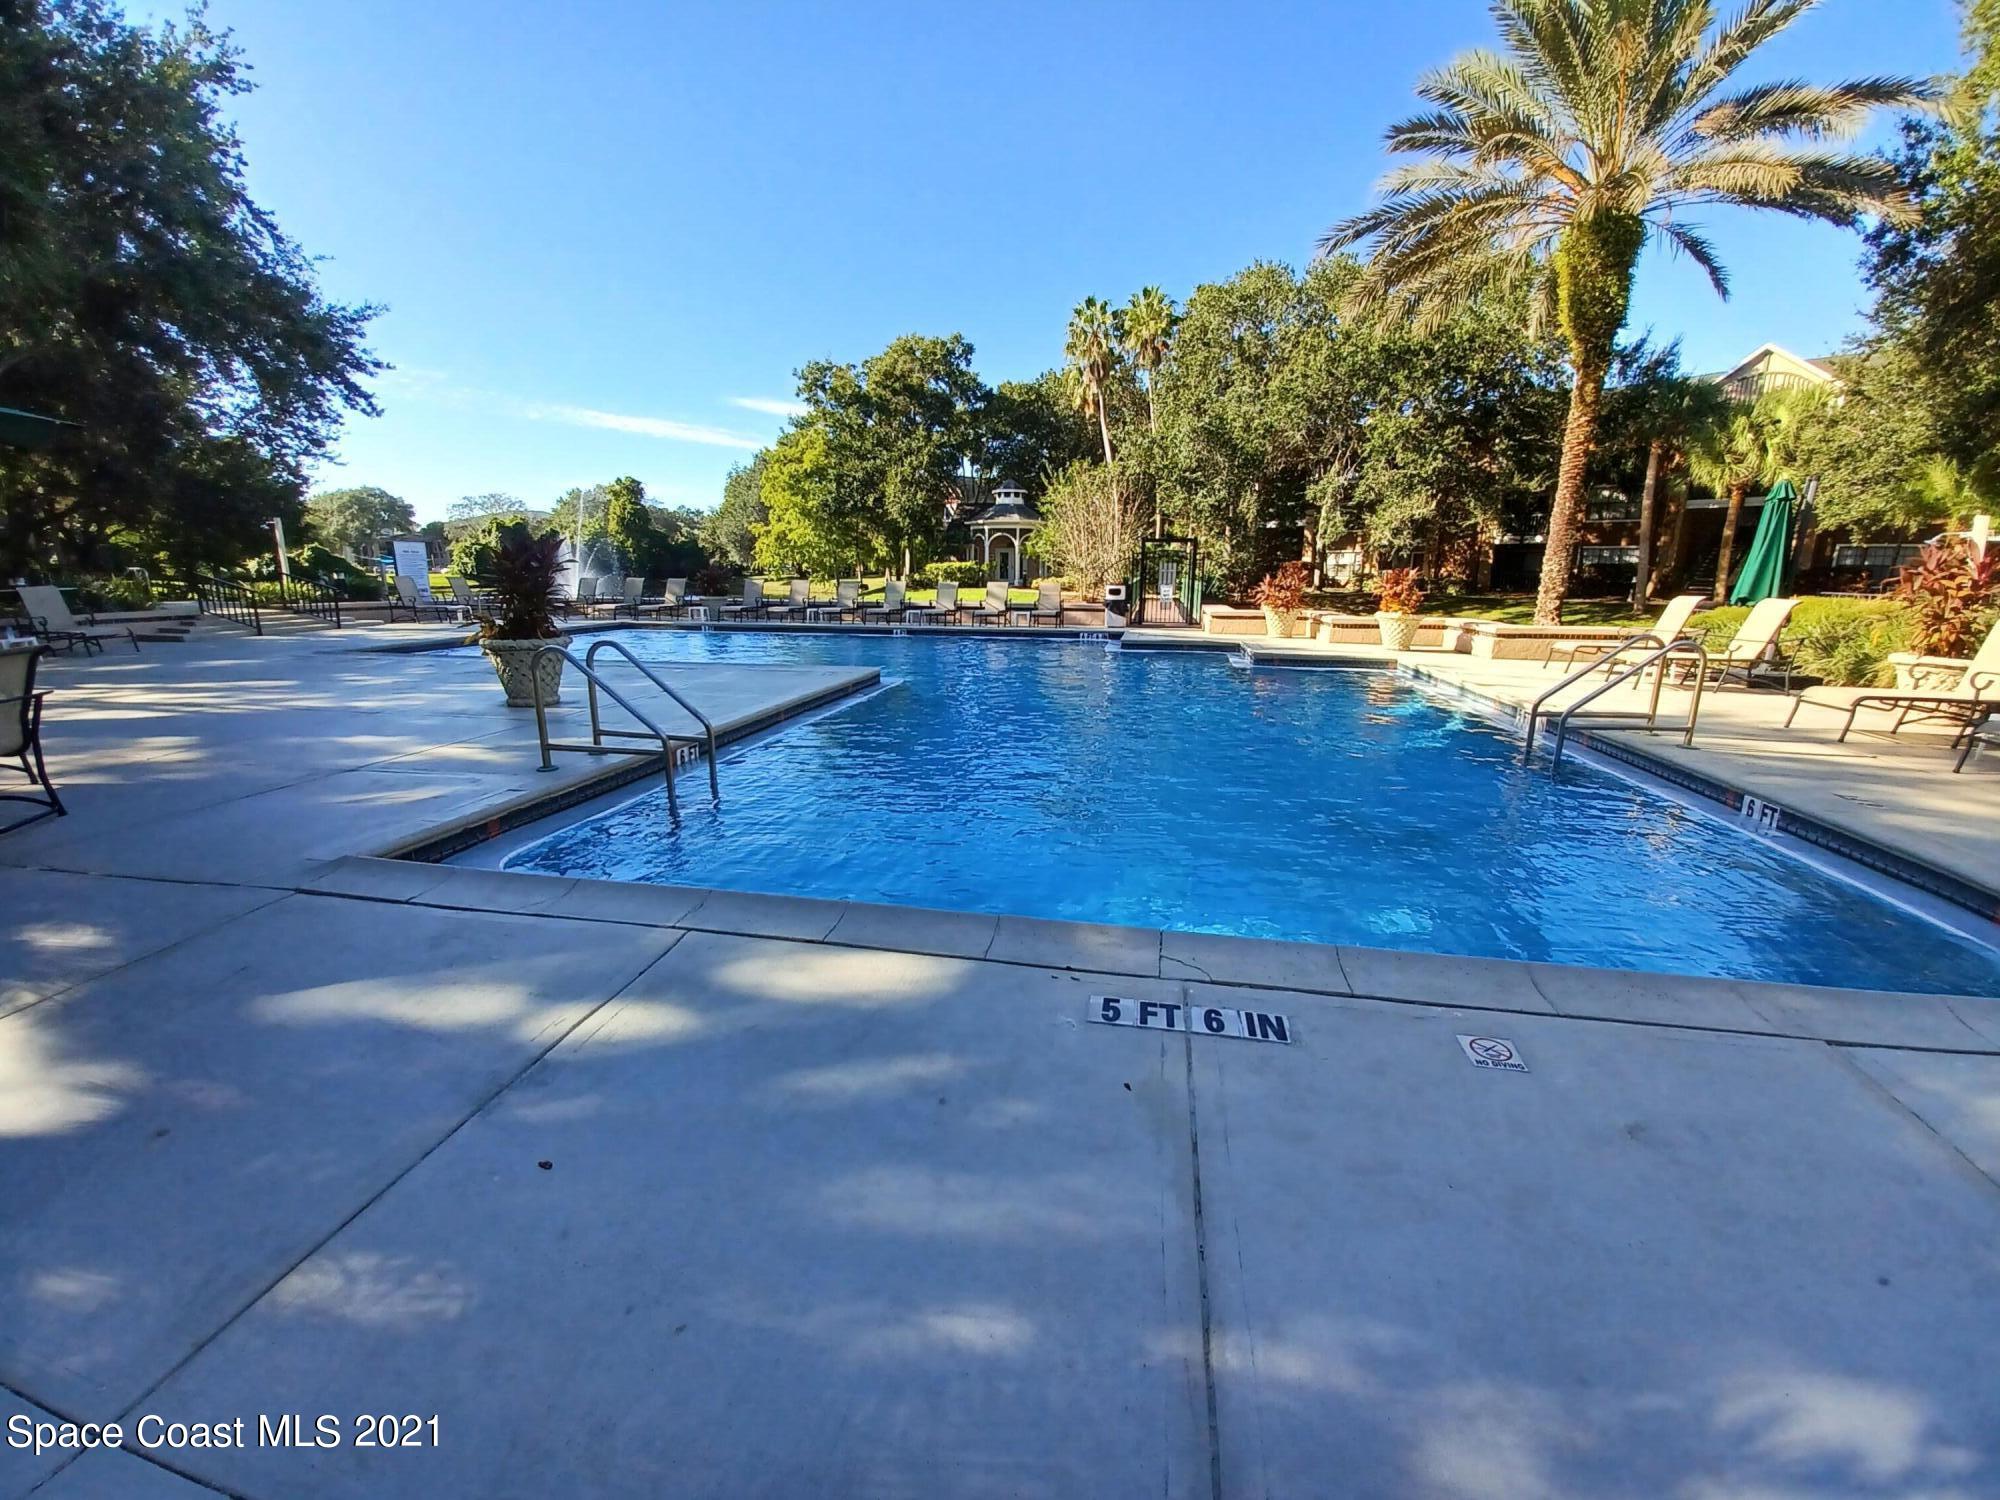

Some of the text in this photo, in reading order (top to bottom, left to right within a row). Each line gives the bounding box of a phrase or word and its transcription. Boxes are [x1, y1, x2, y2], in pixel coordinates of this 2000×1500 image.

[1747, 799, 1779, 827] 6 FT
[1101, 997, 1288, 1041] 5 FT 6 IN
[1474, 1059, 1525, 1070] NO DIVING
